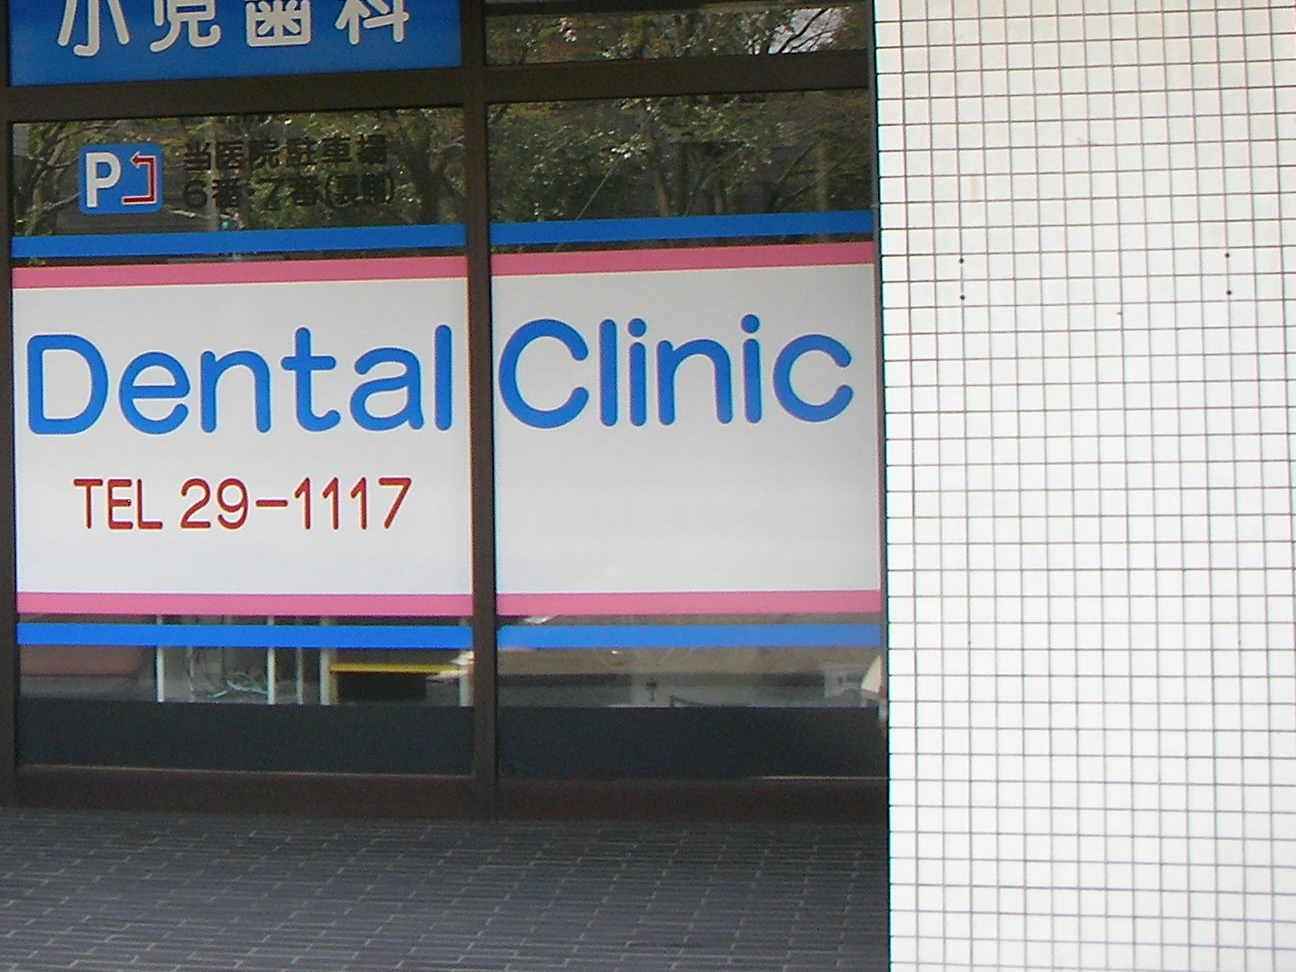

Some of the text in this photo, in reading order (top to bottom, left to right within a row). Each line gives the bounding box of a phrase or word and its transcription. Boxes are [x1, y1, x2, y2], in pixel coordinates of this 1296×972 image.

[85, 151, 122, 209] P
[26, 324, 453, 435] Dental
[498, 313, 854, 429] Clinic
[73, 476, 413, 531] TEL 29-1117
